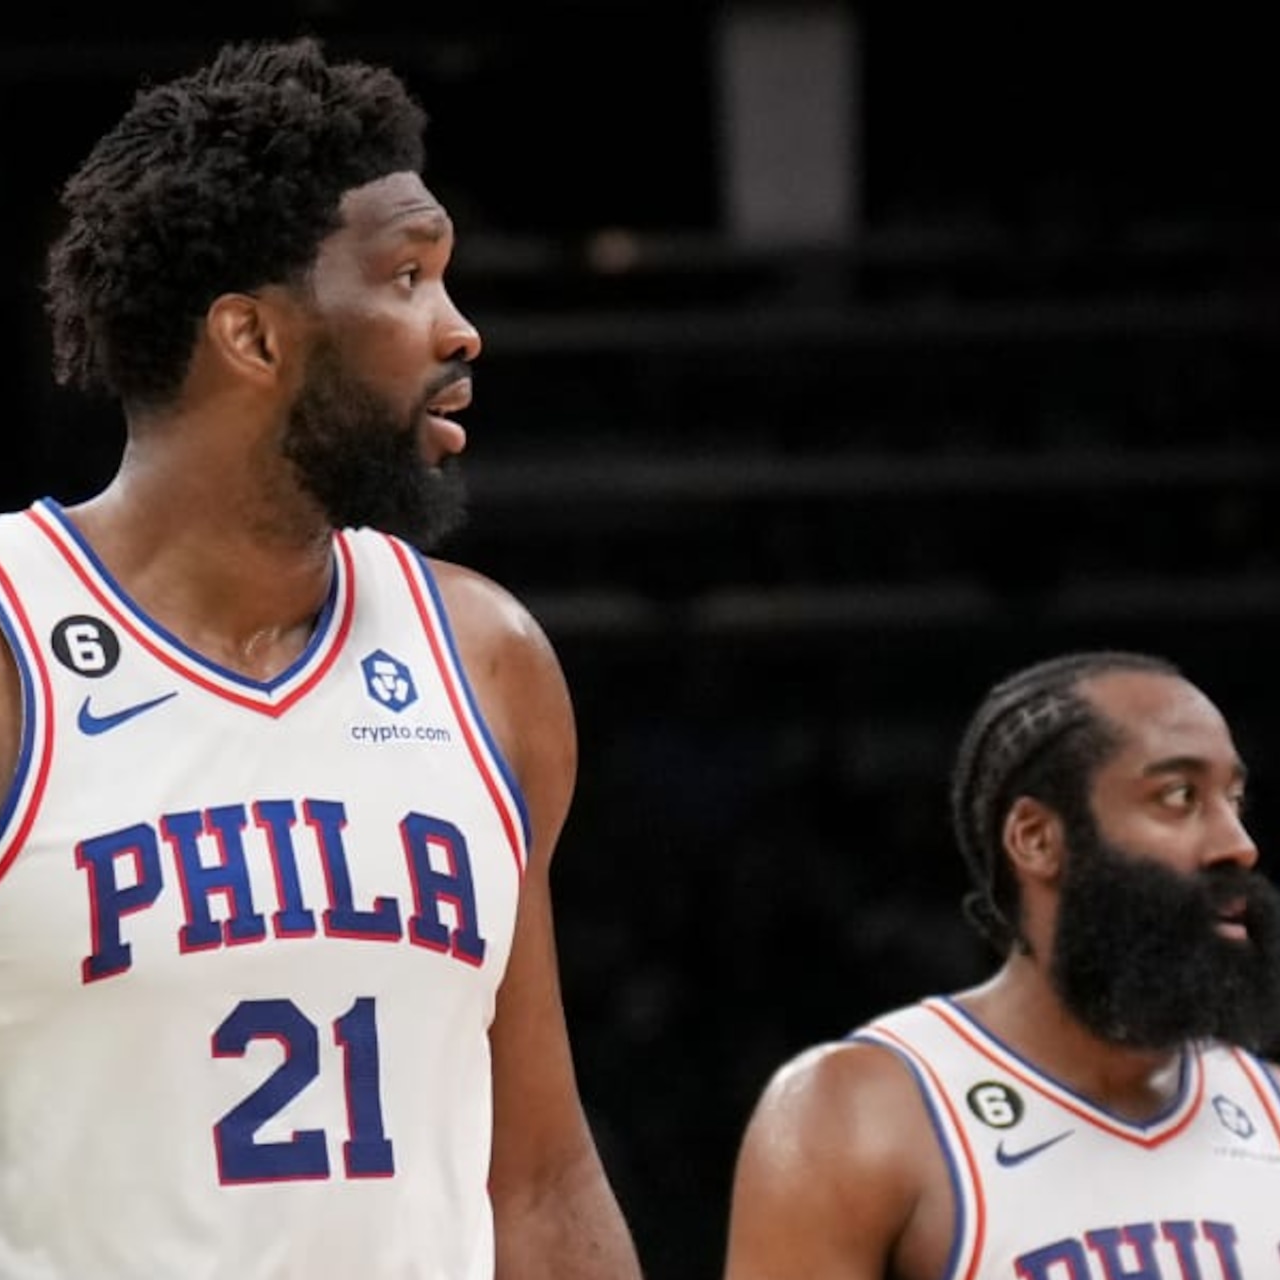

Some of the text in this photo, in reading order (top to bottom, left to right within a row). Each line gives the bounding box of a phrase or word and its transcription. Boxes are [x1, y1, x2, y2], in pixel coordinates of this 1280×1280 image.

[64, 623, 105, 670] 6
[351, 724, 451, 743] crypto.com
[75, 798, 487, 985] PHILA
[211, 996, 396, 1187] 21
[976, 1086, 1014, 1125] 6
